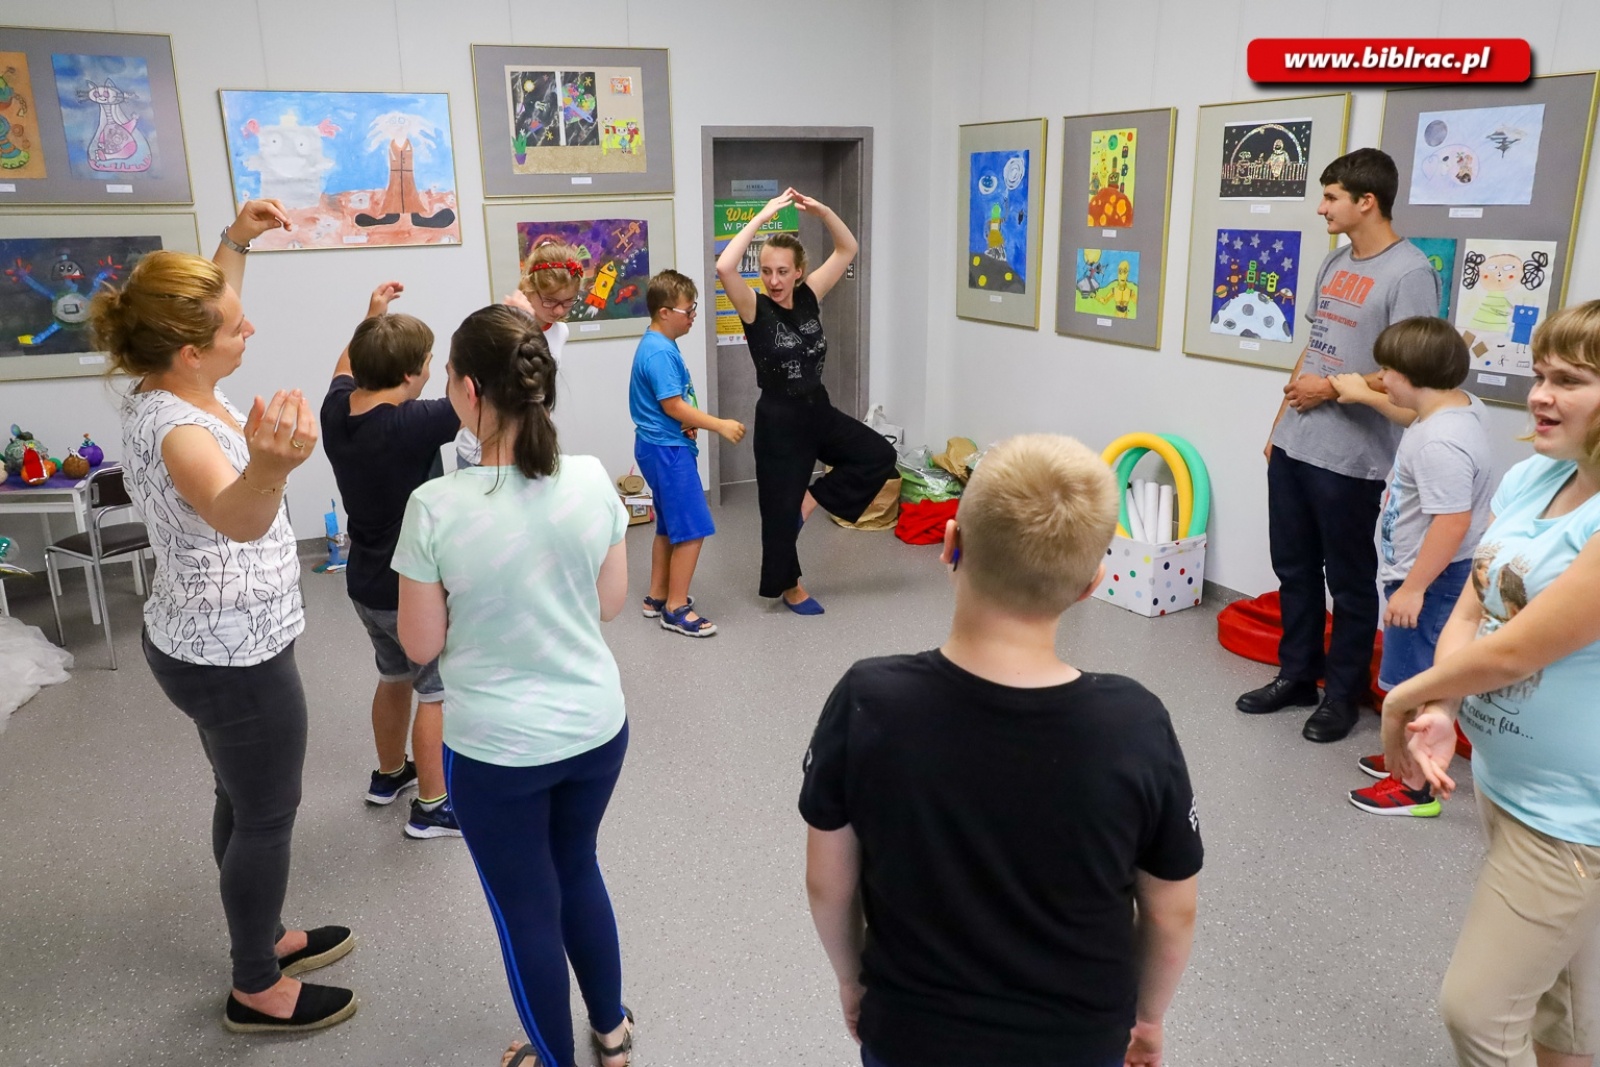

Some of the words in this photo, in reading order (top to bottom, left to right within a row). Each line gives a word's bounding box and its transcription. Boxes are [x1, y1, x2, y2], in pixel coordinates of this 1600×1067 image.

[723, 223, 733, 231] W
[736, 222, 783, 230] POECIE
[1321, 269, 1375, 305] JEAN
[1498, 716, 1534, 740] fits...
